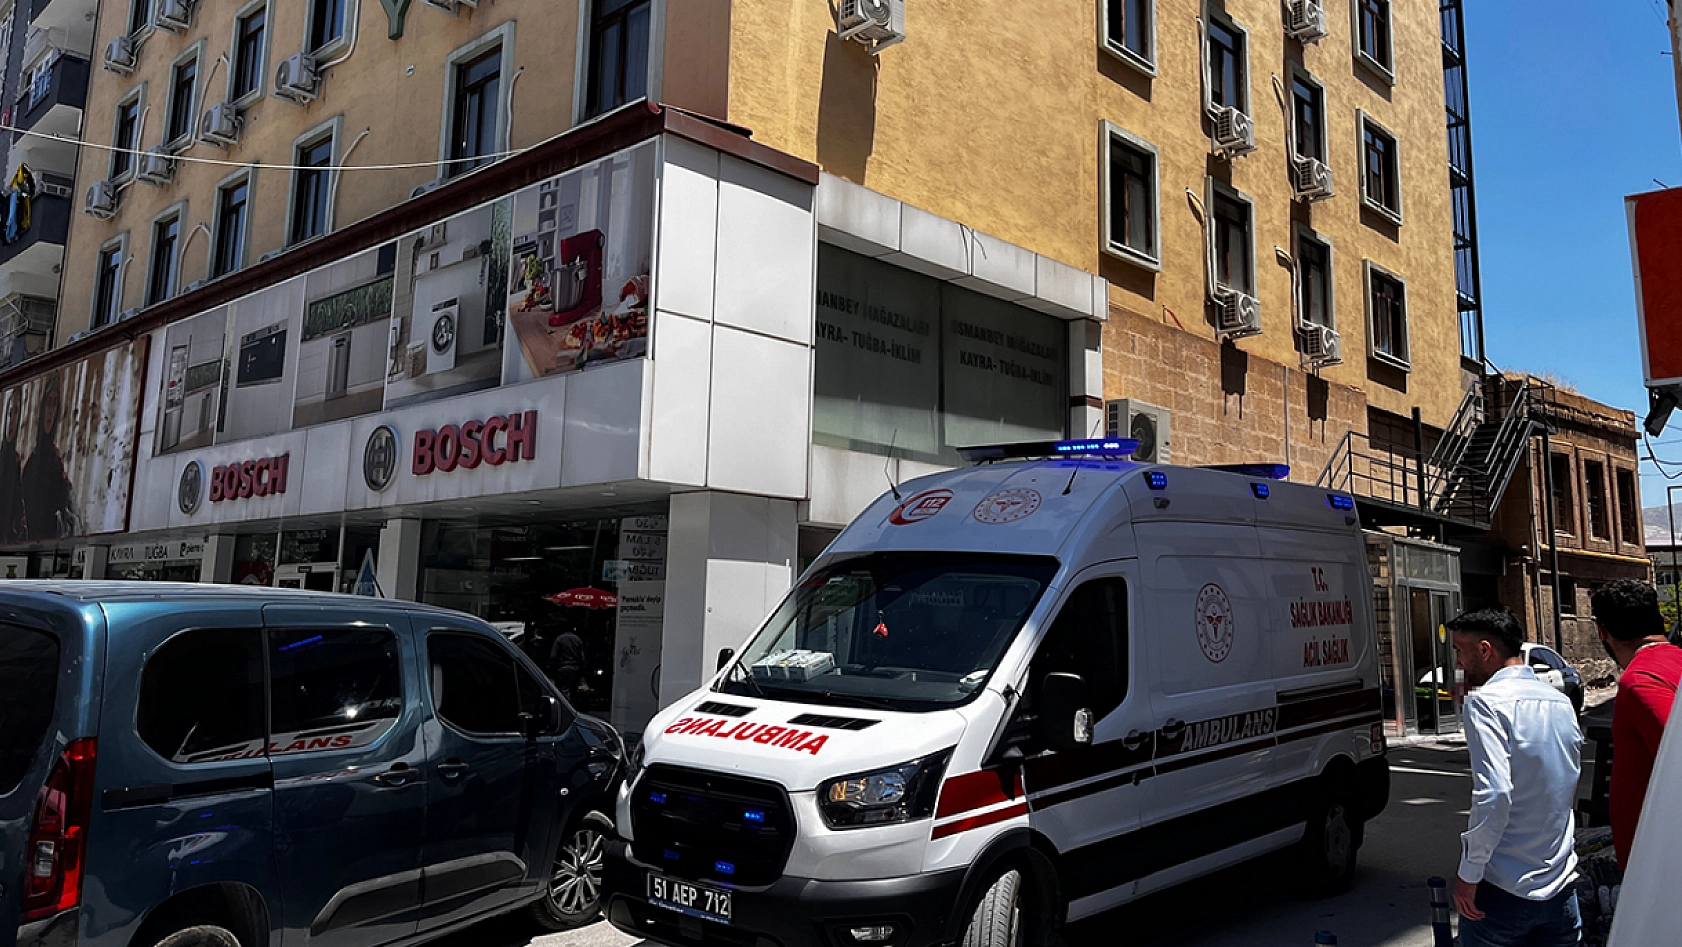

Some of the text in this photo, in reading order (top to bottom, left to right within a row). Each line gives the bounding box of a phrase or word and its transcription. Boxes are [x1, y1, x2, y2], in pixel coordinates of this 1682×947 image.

[412, 410, 538, 475] BOSCH
[209, 453, 290, 502] BOSCH
[1290, 596, 1318, 628] SAĞLIK
[1322, 633, 1349, 665] SAĞLIK
[1180, 709, 1274, 752] AMBULANS
[654, 877, 667, 900] 51
[672, 883, 698, 908] AEP
[705, 891, 729, 916] 712
